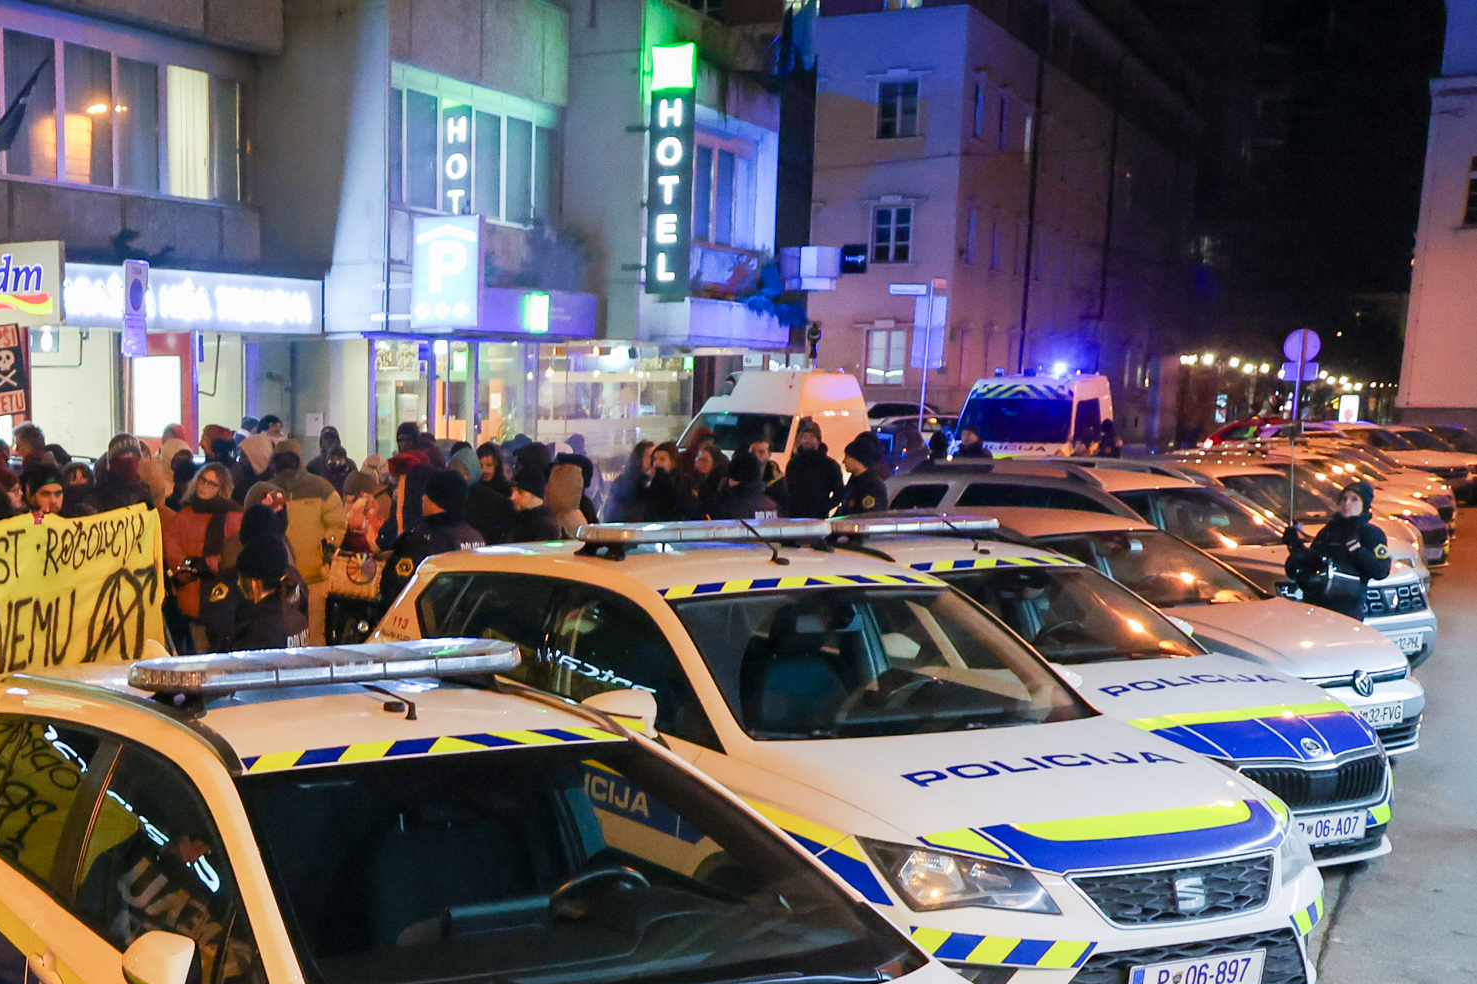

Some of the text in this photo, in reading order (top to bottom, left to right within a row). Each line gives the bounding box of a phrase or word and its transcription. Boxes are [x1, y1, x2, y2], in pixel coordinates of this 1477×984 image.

[657, 97, 682, 282] HOTEL
[393, 616, 409, 630] 113
[1097, 673, 1288, 697] POLICIJA
[1369, 705, 1401, 723] 32-FVG
[900, 750, 1186, 788] POLICIJA
[1315, 816, 1359, 838] 06-A07
